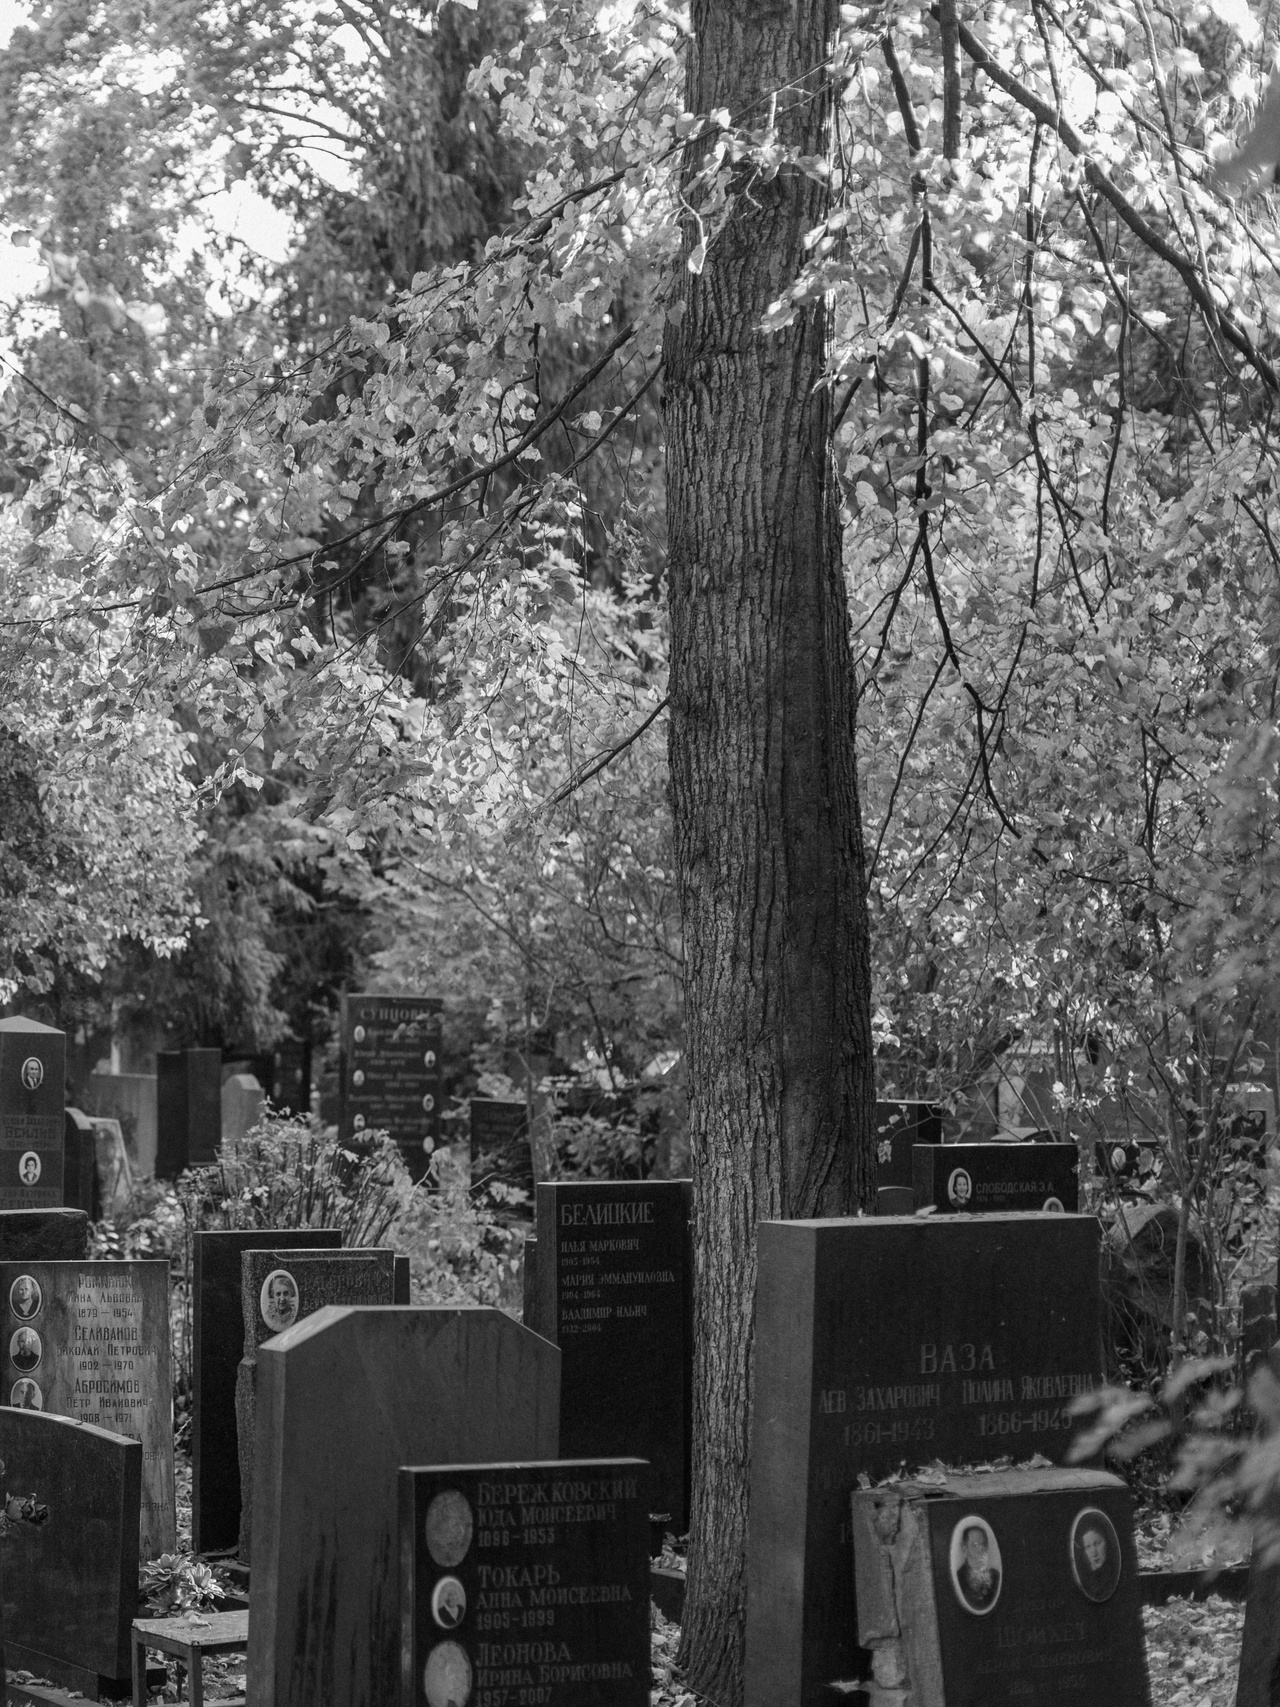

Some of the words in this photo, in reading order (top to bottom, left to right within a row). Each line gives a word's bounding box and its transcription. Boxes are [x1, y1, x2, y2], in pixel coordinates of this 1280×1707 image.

[975, 1181, 1037, 1195] СЛОБОДСКАЯ
[560, 1201, 655, 1227] БЕЛИЦКИЕ
[561, 1240, 586, 1254] ИЛЬЯ
[589, 1238, 640, 1252] МАРКОВИЧ
[562, 1273, 596, 1287] МАРИЯ
[599, 1270, 676, 1285] ЭММАНУИЛОВНА
[78, 1308, 98, 1318] 1879
[113, 1308, 133, 1318] 1954
[561, 1306, 613, 1321] ВЛАДИМИР
[616, 1304, 648, 1318] ИЛЬИЧ
[74, 1325, 138, 1341] СЕЛИВАНОВ
[107, 1343, 158, 1356] ПЕТРОВИЧ
[919, 1341, 997, 1375] ВАЗА
[79, 1360, 99, 1371] 1902
[114, 1360, 134, 1371] 1970
[74, 1378, 140, 1394] АБРОСИМОВ
[819, 1388, 847, 1414] ЛЕВ
[856, 1382, 942, 1412] ЗАХАРОВИЧ
[961, 1378, 1015, 1405] ПОЛИНА
[1020, 1372, 1095, 1401] ЯКОВЛЕВНА
[99, 1396, 149, 1408] ИВАНОВИЧ
[842, 1416, 937, 1447] 1861-1943
[476, 1506, 518, 1528] ЮДА
[520, 1502, 618, 1525] МОИСЕЕВИЧ
[476, 1562, 561, 1589] ТОКАРЬ
[475, 1589, 523, 1610] АННА
[527, 1584, 634, 1607] МОИСЕЕВНА
[475, 1608, 556, 1631] 1905-1999
[475, 1640, 572, 1668] ЛЕОНОВА
[475, 1667, 535, 1688] ИРИНА
[538, 1660, 635, 1683] БОРИСОВНА
[475, 1685, 554, 1707] 1957-2007
